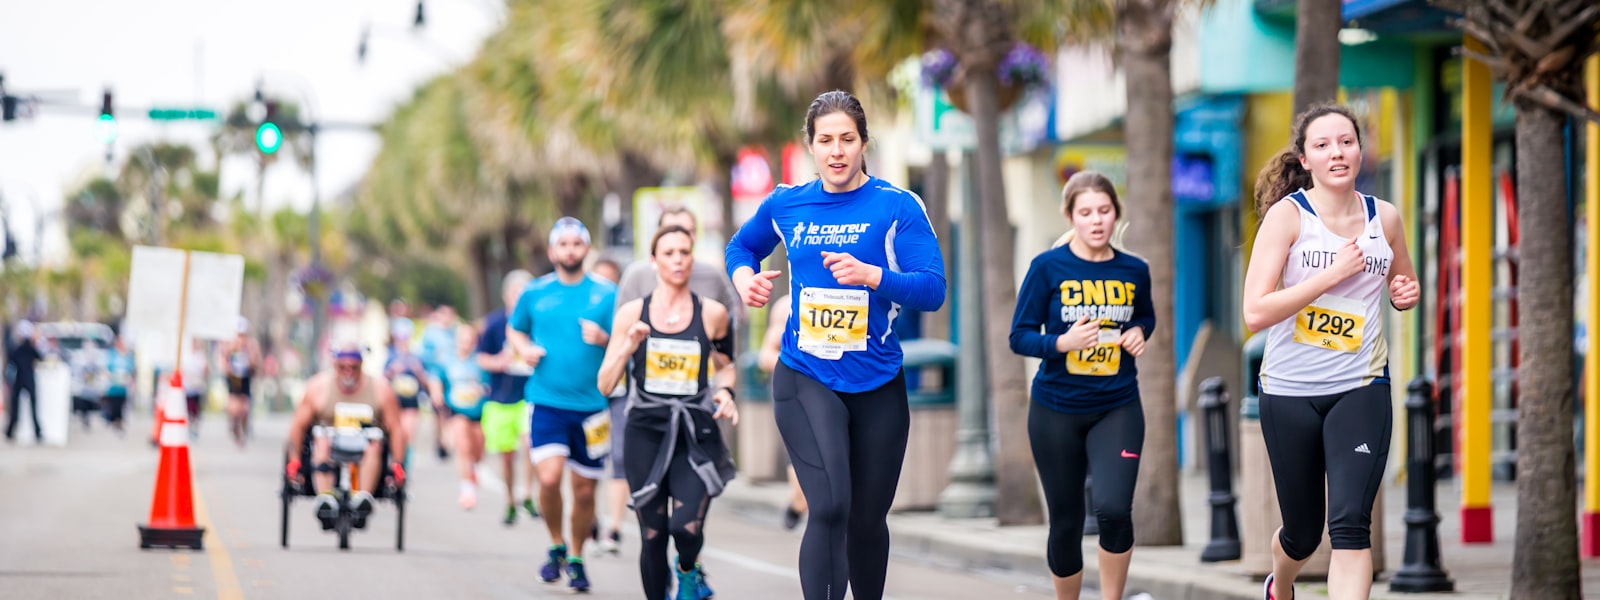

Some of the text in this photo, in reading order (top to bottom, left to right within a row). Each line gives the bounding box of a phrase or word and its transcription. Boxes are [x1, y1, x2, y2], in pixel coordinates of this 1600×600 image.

[807, 221, 870, 234] le coureur
[804, 233, 859, 247] nordique
[1363, 256, 1388, 276] AME
[809, 308, 859, 329] 1027
[1061, 305, 1097, 322] CROSS
[1307, 310, 1355, 338] 1292
[1322, 339, 1332, 347] 5K
[659, 354, 686, 370] 567
[1078, 346, 1115, 363] 1297
